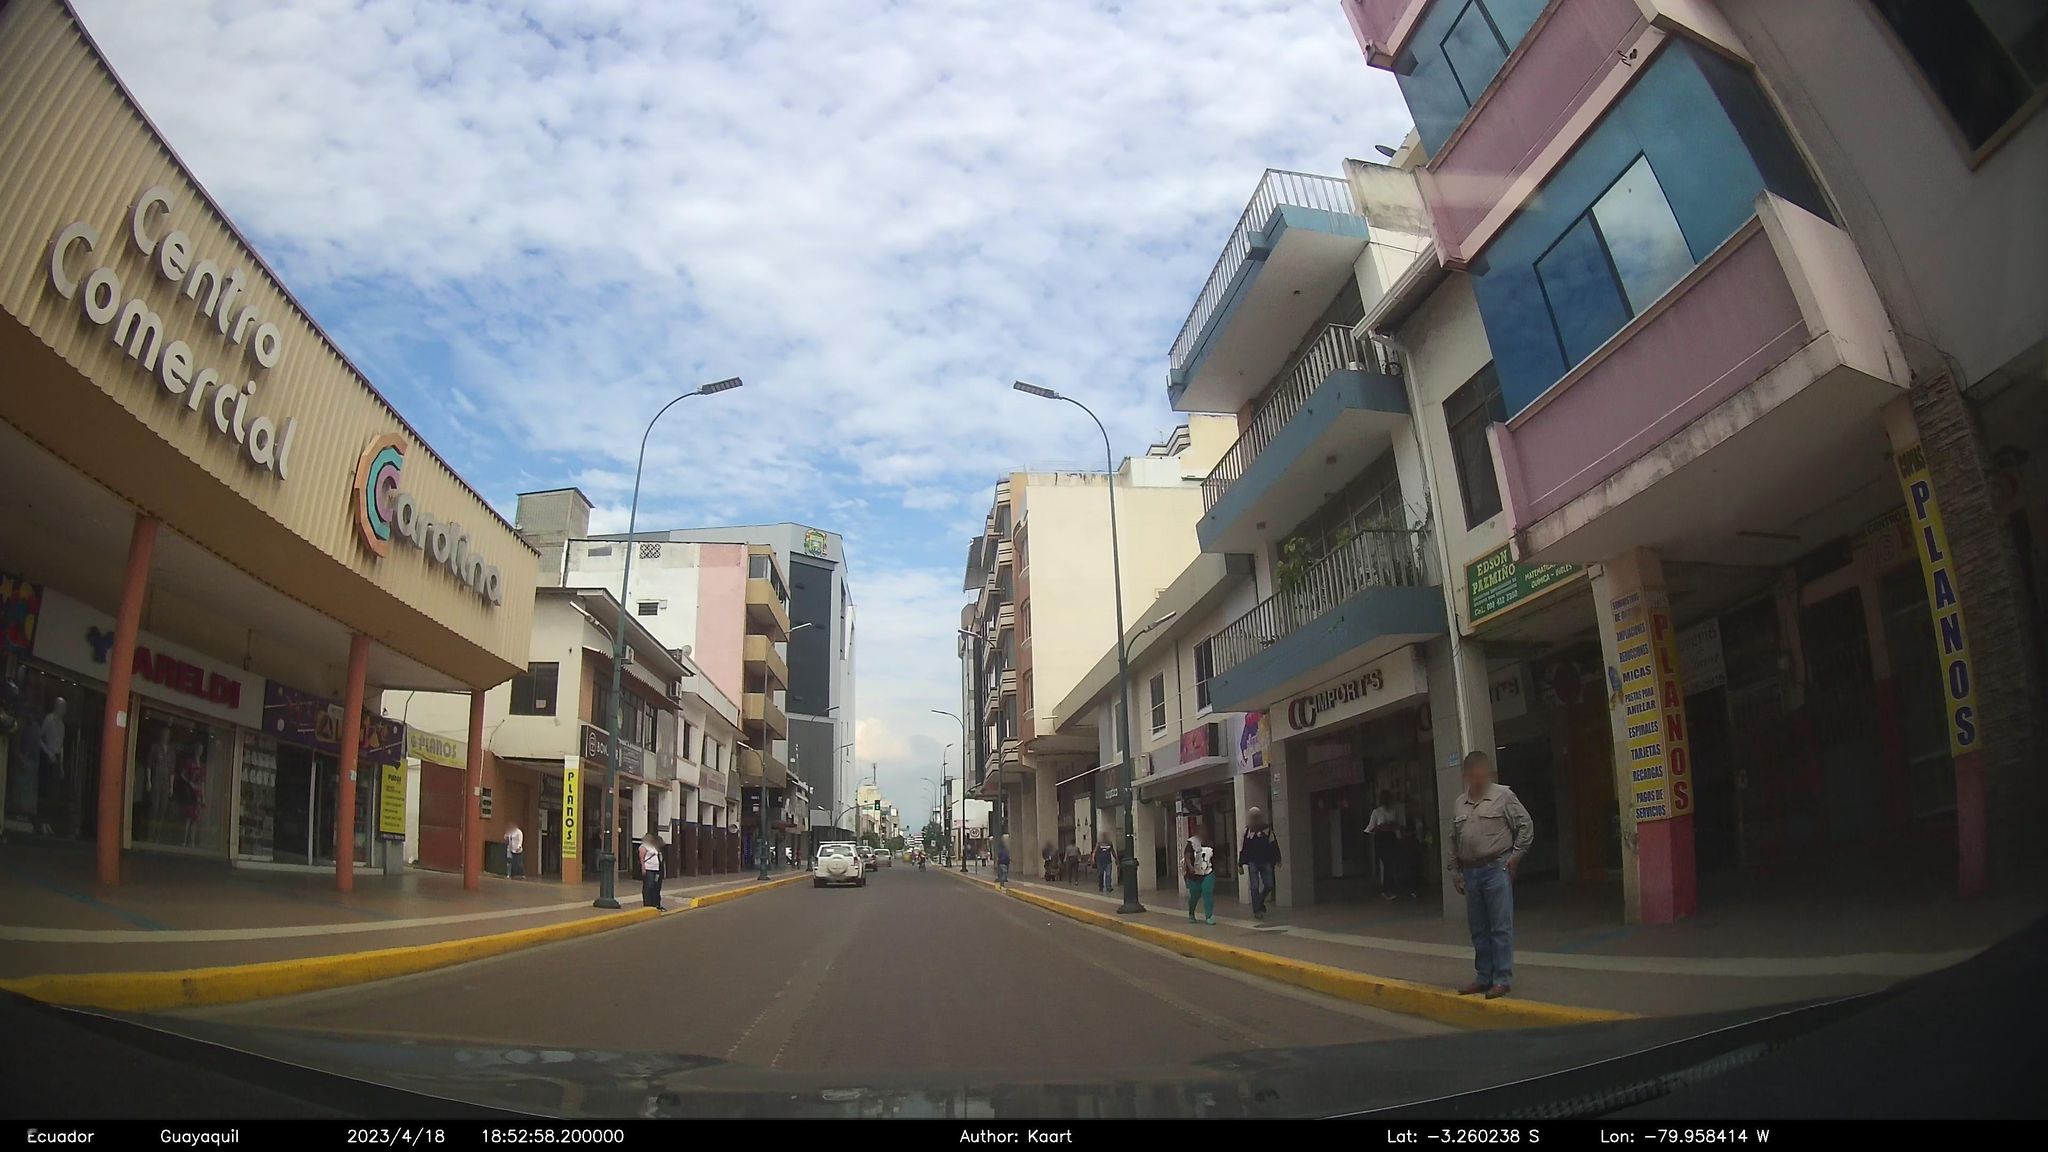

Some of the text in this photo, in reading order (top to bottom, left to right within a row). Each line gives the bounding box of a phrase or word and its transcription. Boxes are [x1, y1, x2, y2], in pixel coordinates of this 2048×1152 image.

[132, 186, 282, 369] Centro
[49, 221, 298, 481] Comercial
[353, 433, 501, 606] Carolina
[1476, 549, 1508, 577] EDSON
[1471, 562, 1516, 595] PAZMIÑO
[1910, 480, 1976, 746] PLANOS
[1622, 665, 1652, 683] MICAS
[1627, 699, 1656, 716] ANILLAR
[1653, 613, 1689, 810] PLANOS
[1628, 720, 1659, 738] ESPIRALES
[419, 734, 457, 759] PLANOS
[1630, 743, 1661, 761] TARJETAS
[1632, 765, 1664, 782] RECARGAS
[565, 772, 575, 840] PLANOS
[1636, 788, 1664, 803] PAGOS DE
[1635, 804, 1666, 819] SERVICIOS
